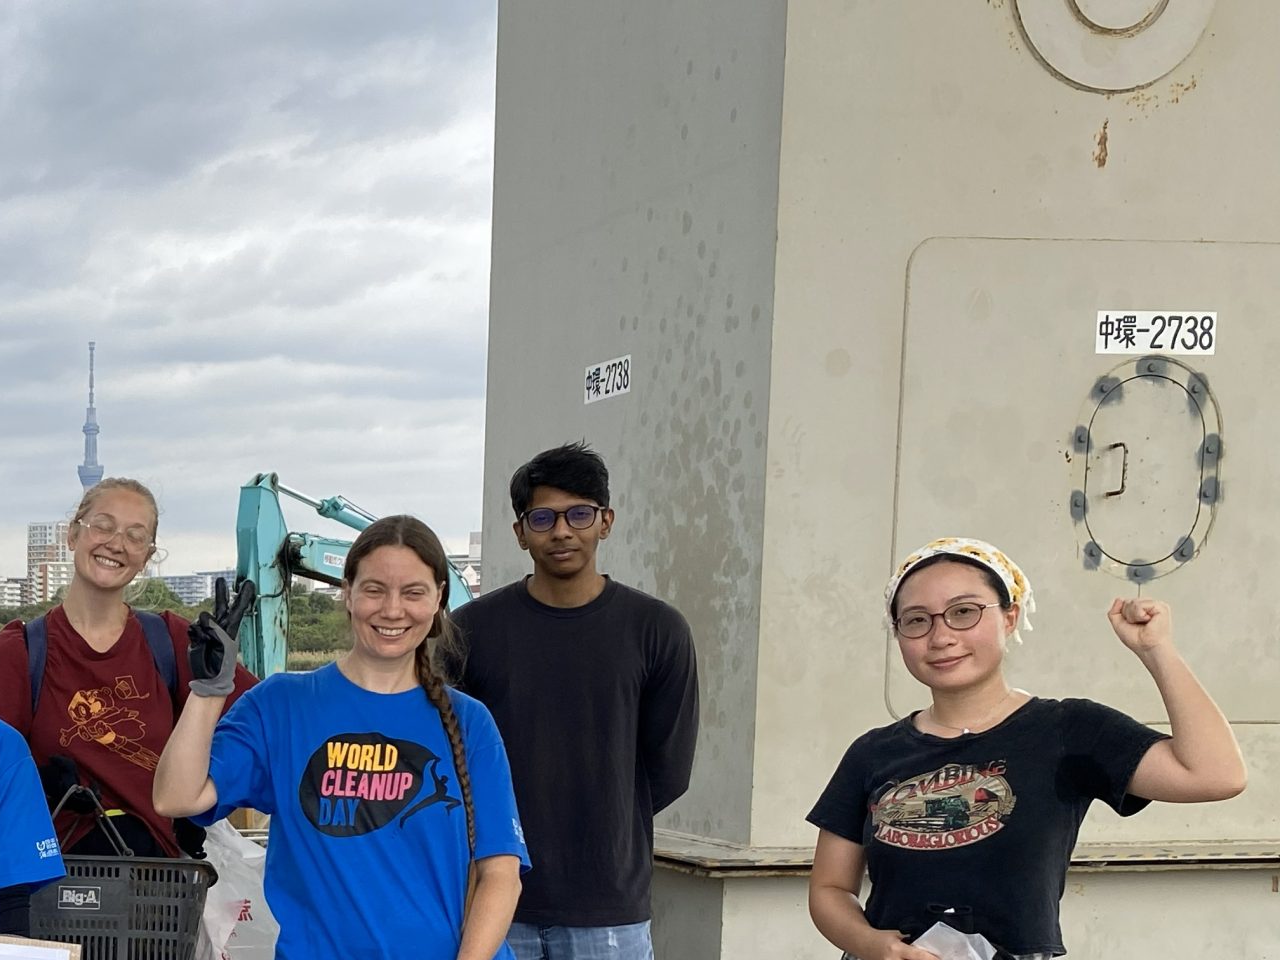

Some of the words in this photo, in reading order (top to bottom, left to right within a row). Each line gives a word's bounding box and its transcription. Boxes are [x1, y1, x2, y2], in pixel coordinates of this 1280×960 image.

[1099, 315, 1214, 350] 中環-2738
[586, 358, 630, 400] 中環-2738
[327, 741, 398, 771] WORLD
[321, 769, 413, 800] CLEANUP
[319, 797, 360, 826] DAY
